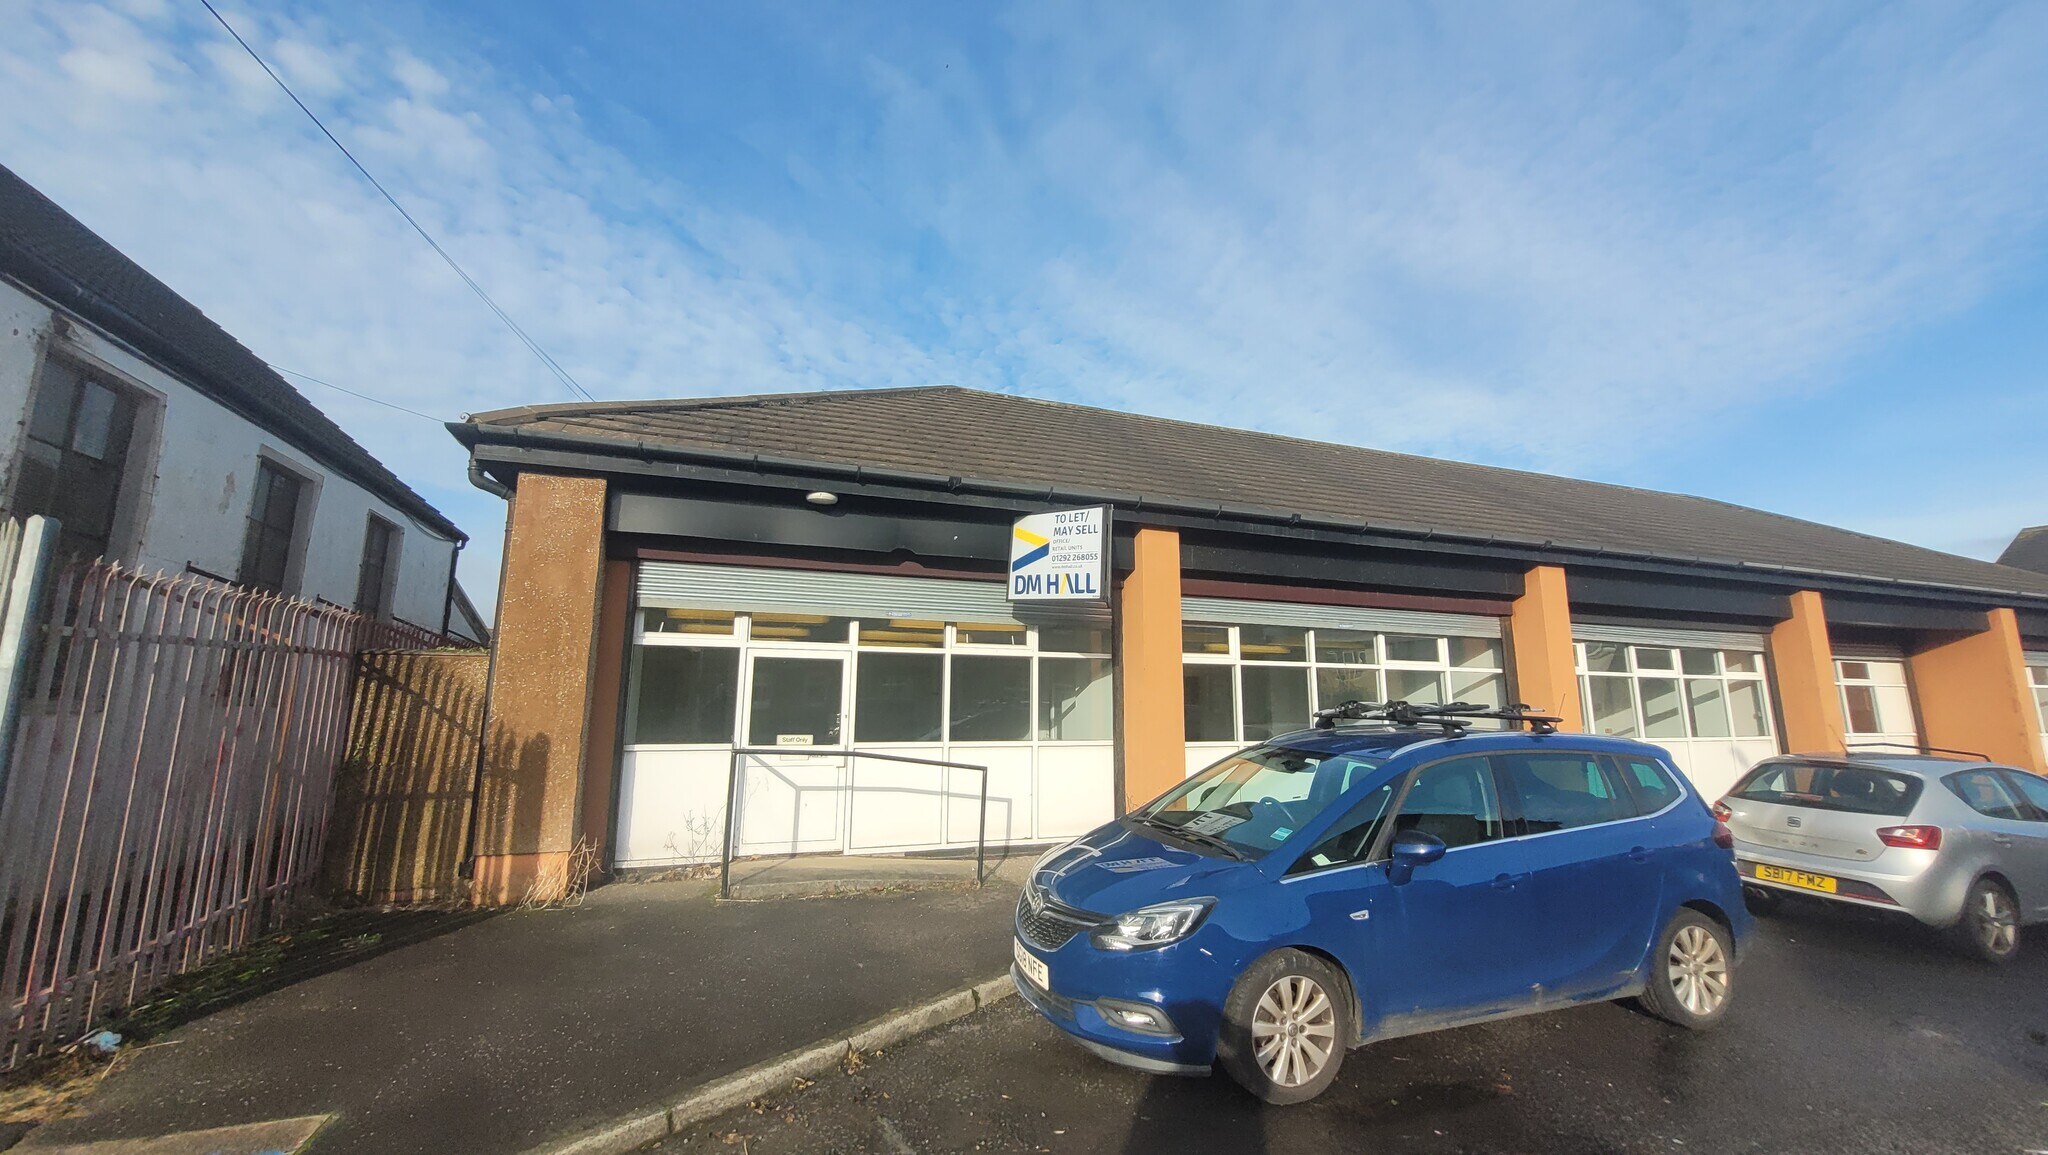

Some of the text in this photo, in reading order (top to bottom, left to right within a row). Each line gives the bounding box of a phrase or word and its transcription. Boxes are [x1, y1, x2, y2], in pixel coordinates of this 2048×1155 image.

[1055, 511, 1090, 524] TO LET/
[1053, 524, 1099, 536] MAY SELL
[1051, 553, 1099, 562] 01292 268055
[1014, 572, 1097, 595] DM HALL
[1763, 866, 1825, 888] SB17 FMZ
[1028, 955, 1043, 982] NFE
